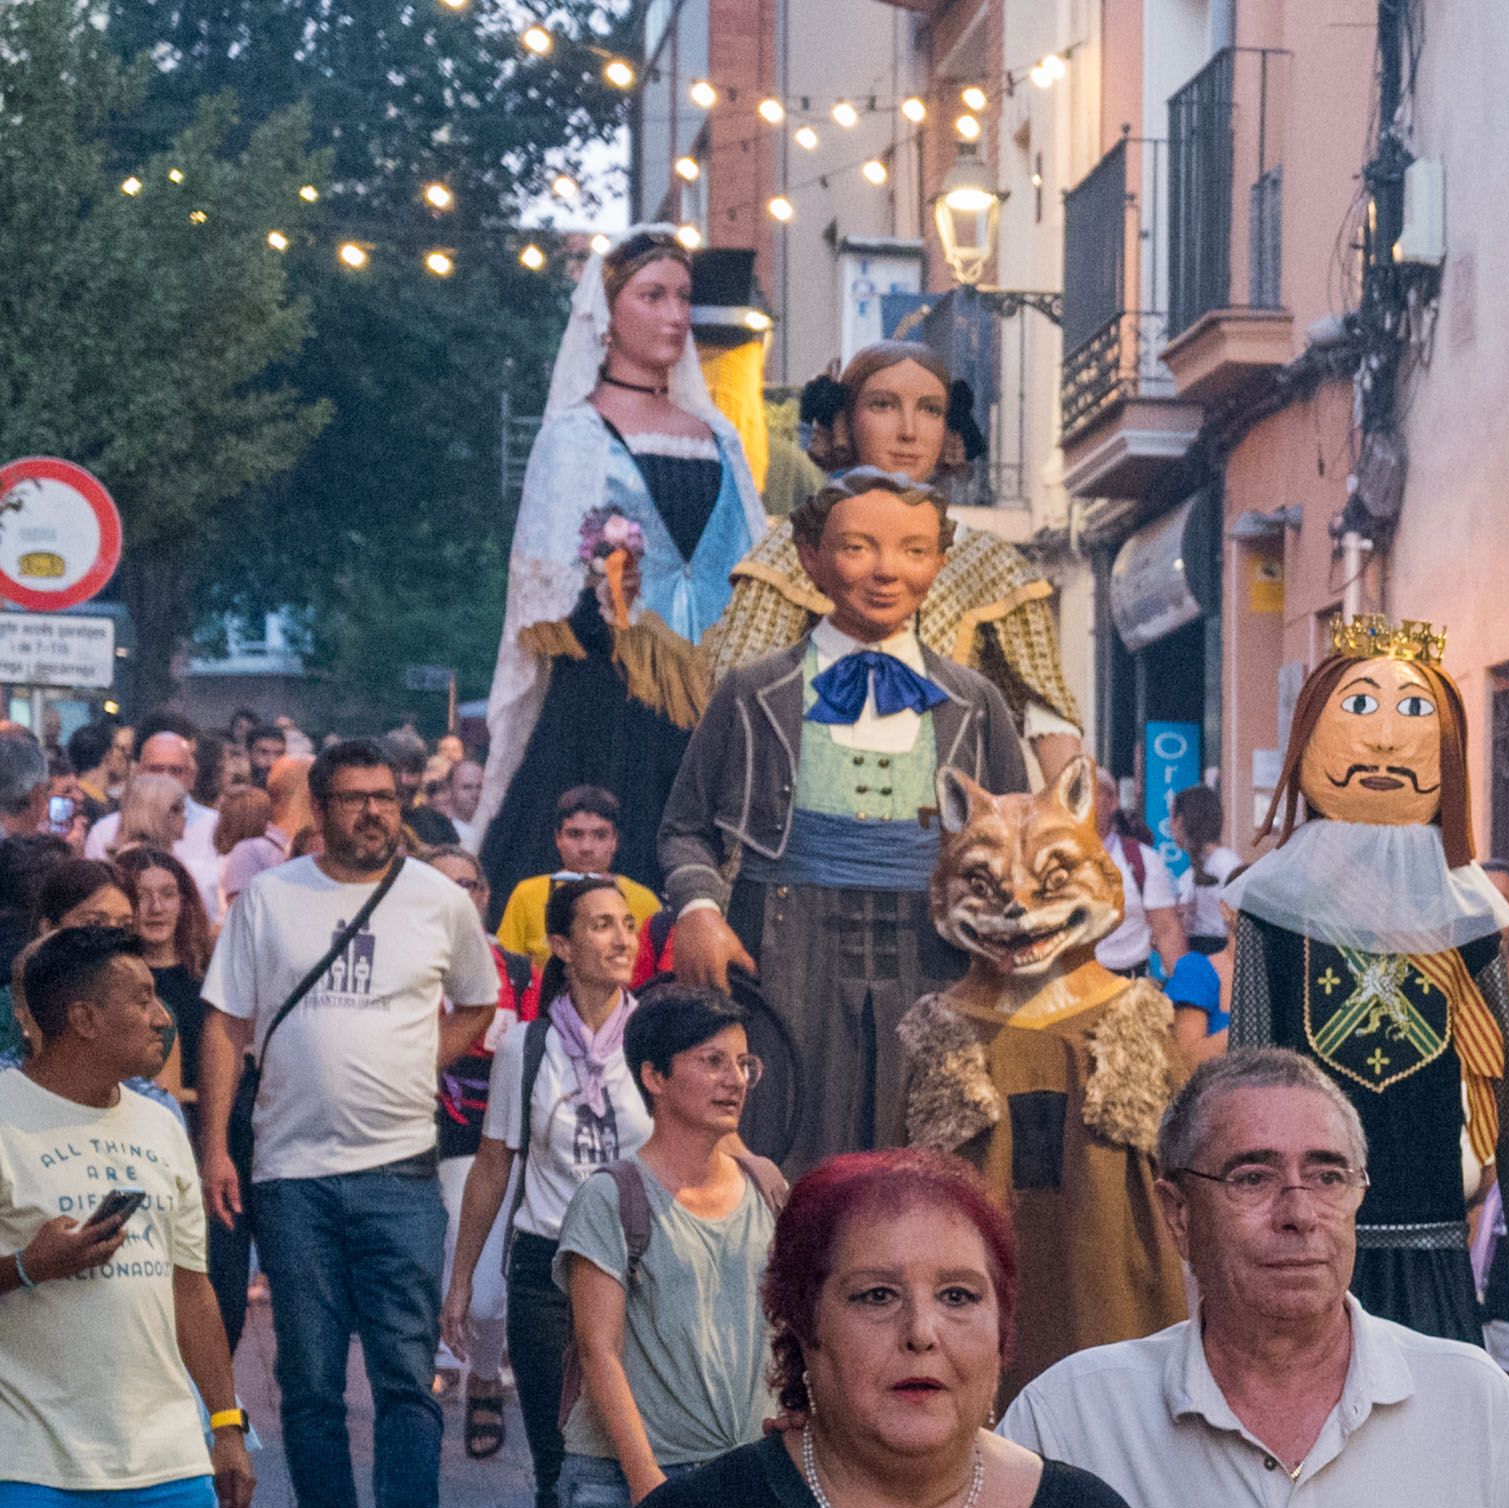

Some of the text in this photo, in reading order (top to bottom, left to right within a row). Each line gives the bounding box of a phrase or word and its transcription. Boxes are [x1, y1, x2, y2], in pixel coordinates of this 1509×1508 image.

[40, 1138, 170, 1168] ALL THING
[86, 1165, 138, 1181] ARE
[57, 1194, 174, 1213] DIFULT
